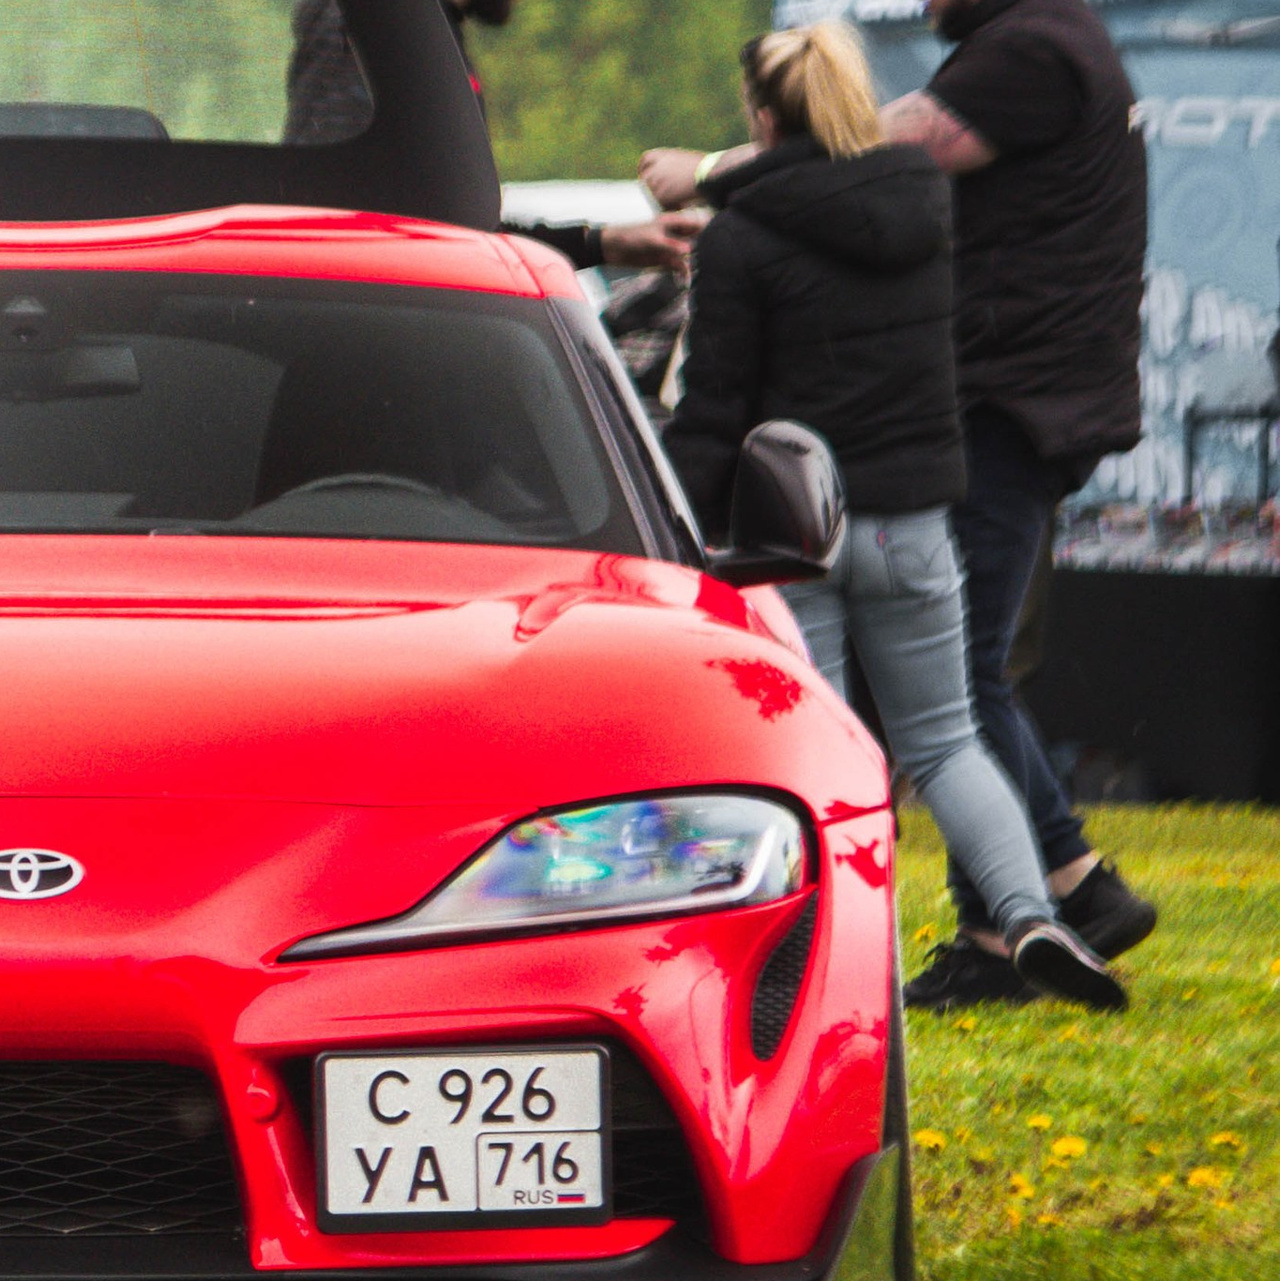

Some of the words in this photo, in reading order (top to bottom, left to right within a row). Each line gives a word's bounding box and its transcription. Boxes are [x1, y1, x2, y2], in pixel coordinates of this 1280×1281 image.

[368, 1070, 411, 1125] С
[439, 1066, 556, 1124] 926
[354, 1146, 449, 1203] УА
[488, 1141, 579, 1186] 716
[514, 1190, 554, 1204] RUS
